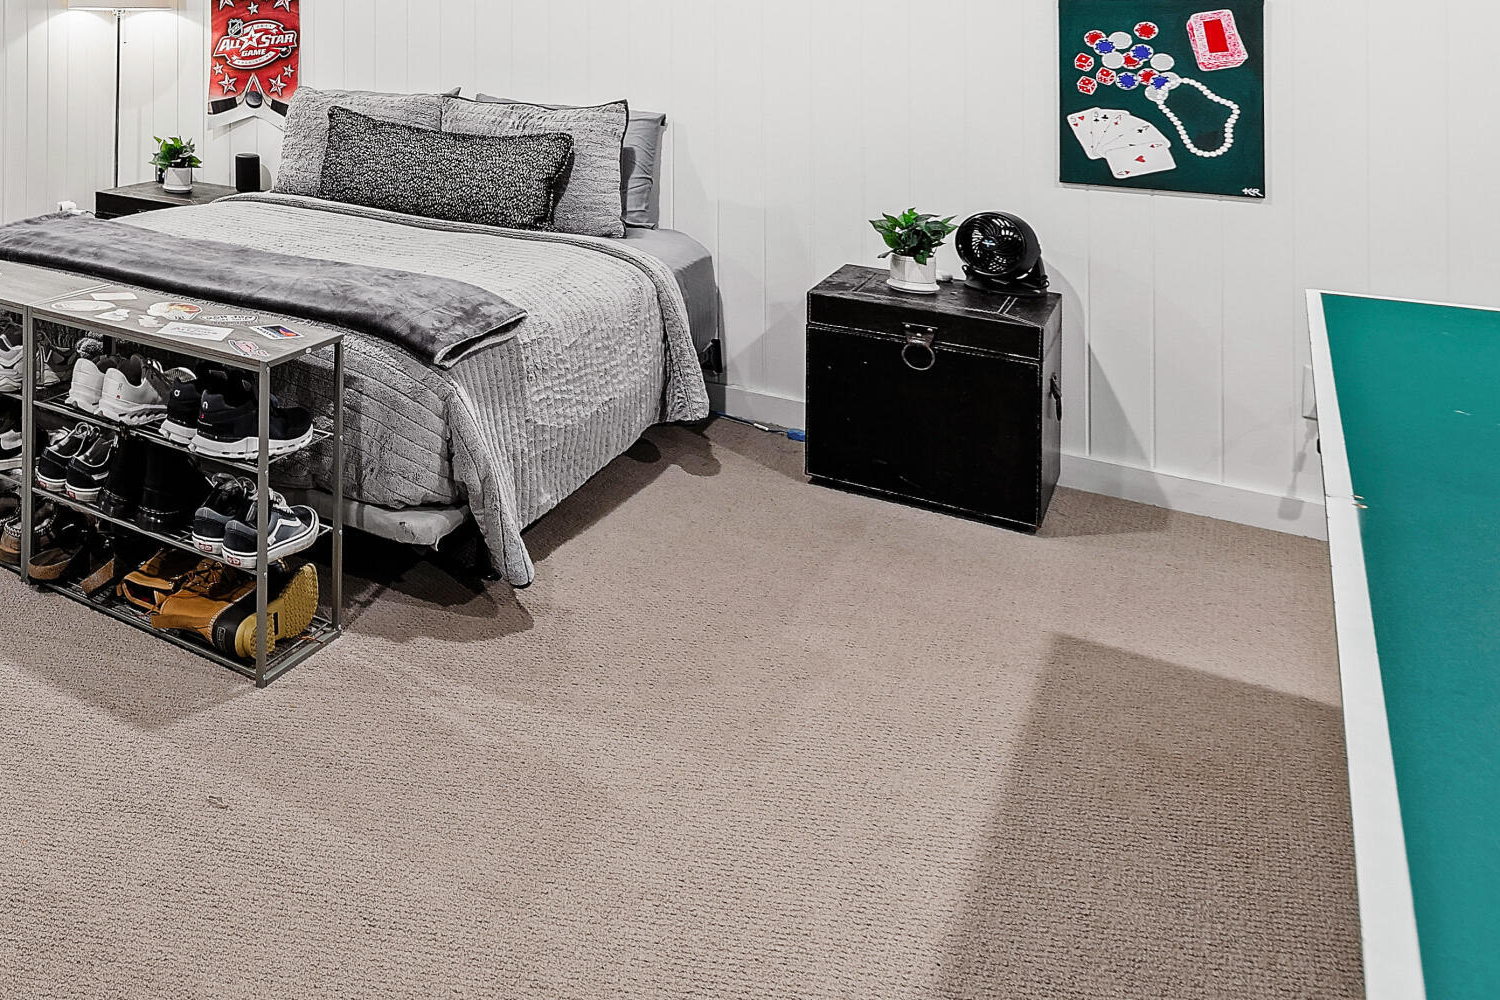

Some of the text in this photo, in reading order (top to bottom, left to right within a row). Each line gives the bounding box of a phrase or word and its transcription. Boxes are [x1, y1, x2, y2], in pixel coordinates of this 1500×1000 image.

[218, 33, 294, 51] ALL STAR
[241, 48, 267, 57] GAME
